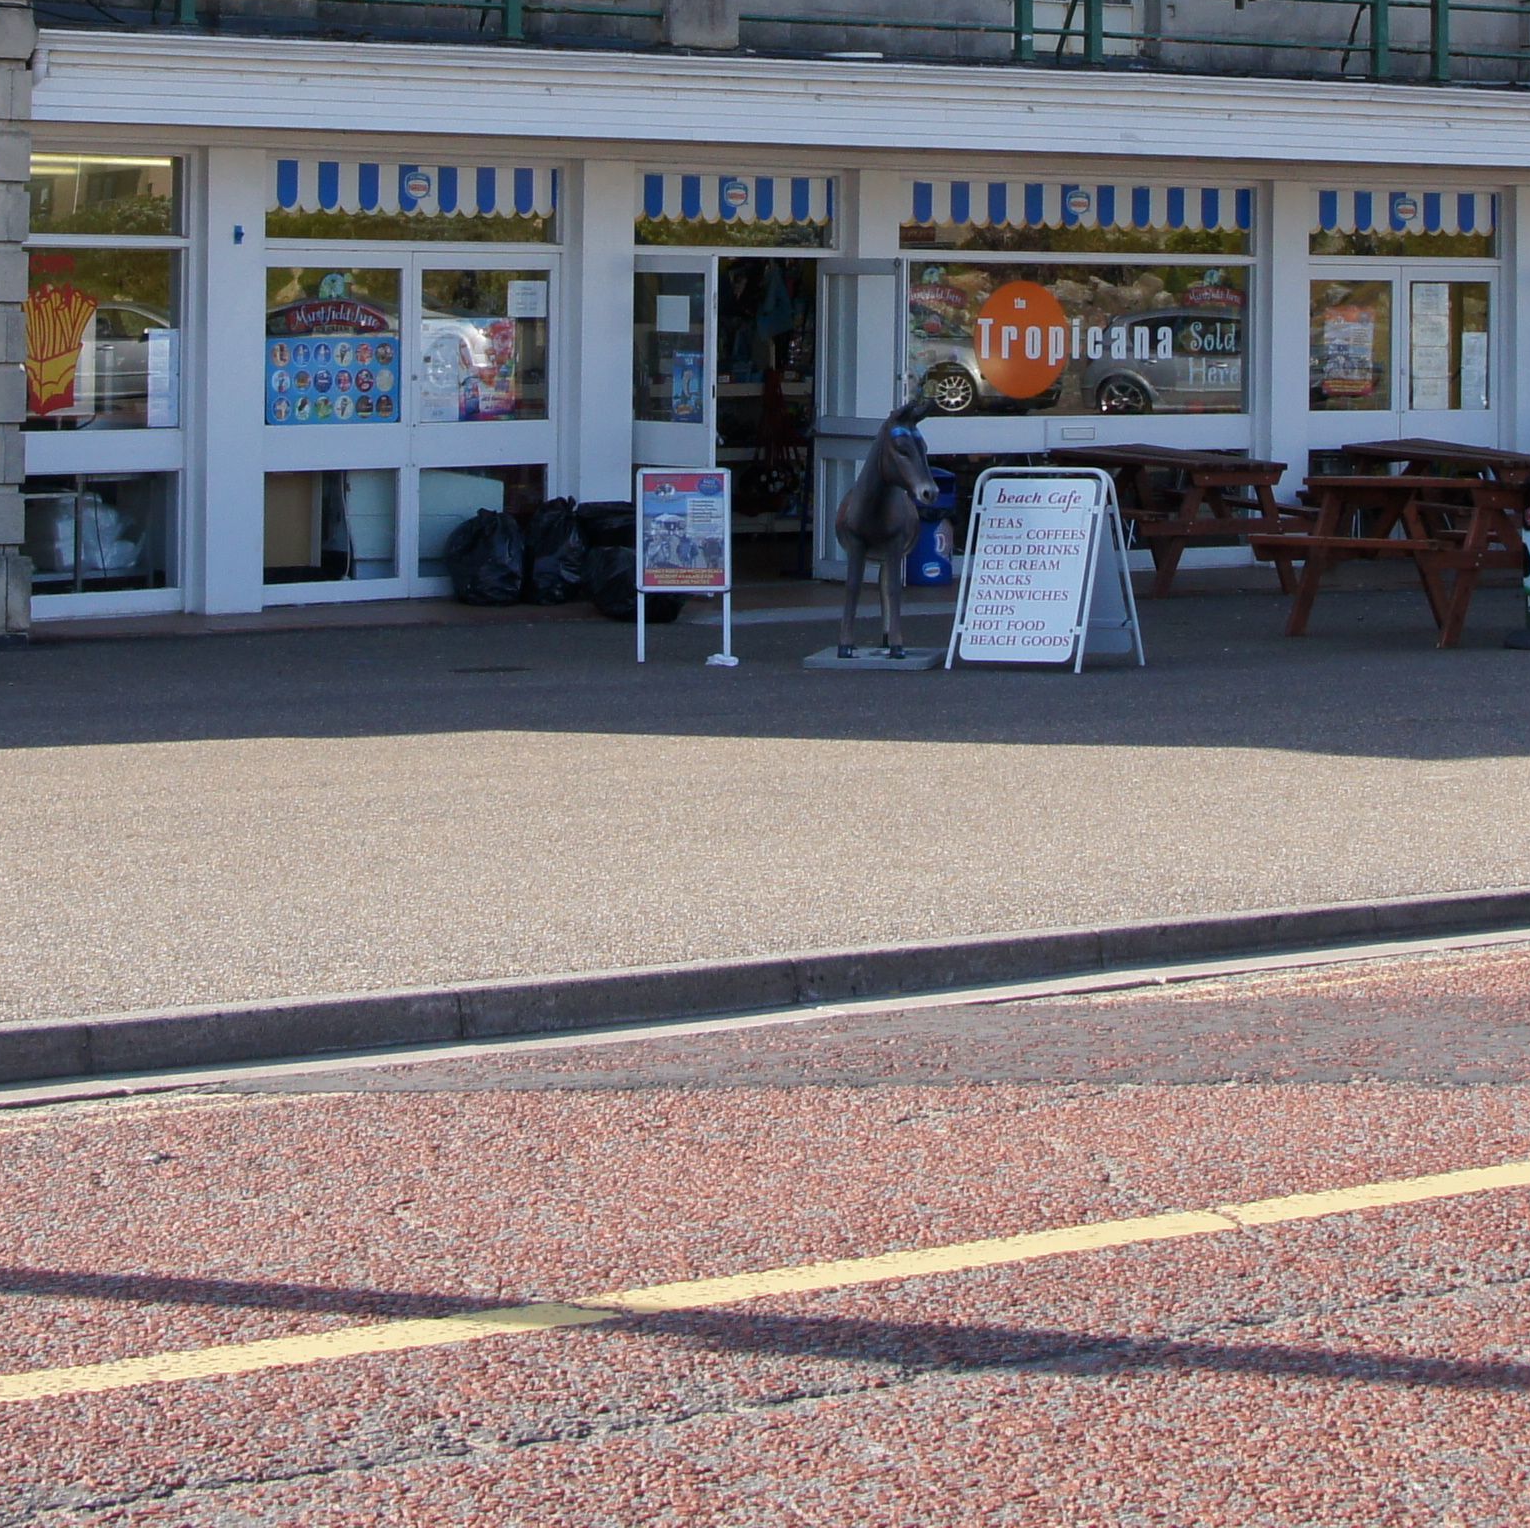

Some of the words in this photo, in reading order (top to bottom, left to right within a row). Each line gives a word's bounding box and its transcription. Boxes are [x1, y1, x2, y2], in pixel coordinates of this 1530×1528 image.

[1013, 296, 1026, 309] the
[976, 317, 1173, 366] Tropicana
[1189, 321, 1236, 353] Sold
[1188, 356, 1242, 386] Here
[997, 487, 1042, 504] beach
[988, 517, 1024, 529] TEAS
[1026, 528, 1086, 541] COFFEES
[983, 544, 1022, 555] COLD
[1026, 544, 1080, 556] DRINKS
[981, 559, 1004, 570] ICE
[1008, 559, 1061, 571] CREAM
[978, 574, 1032, 586] SNACKS
[975, 589, 1069, 601] SANDWICHES
[974, 604, 1016, 616] CHIPS
[972, 619, 1002, 631] HOT
[1006, 620, 1046, 631] FOOD
[969, 635, 1016, 646] BEACH
[1021, 636, 1070, 647] GOODS
